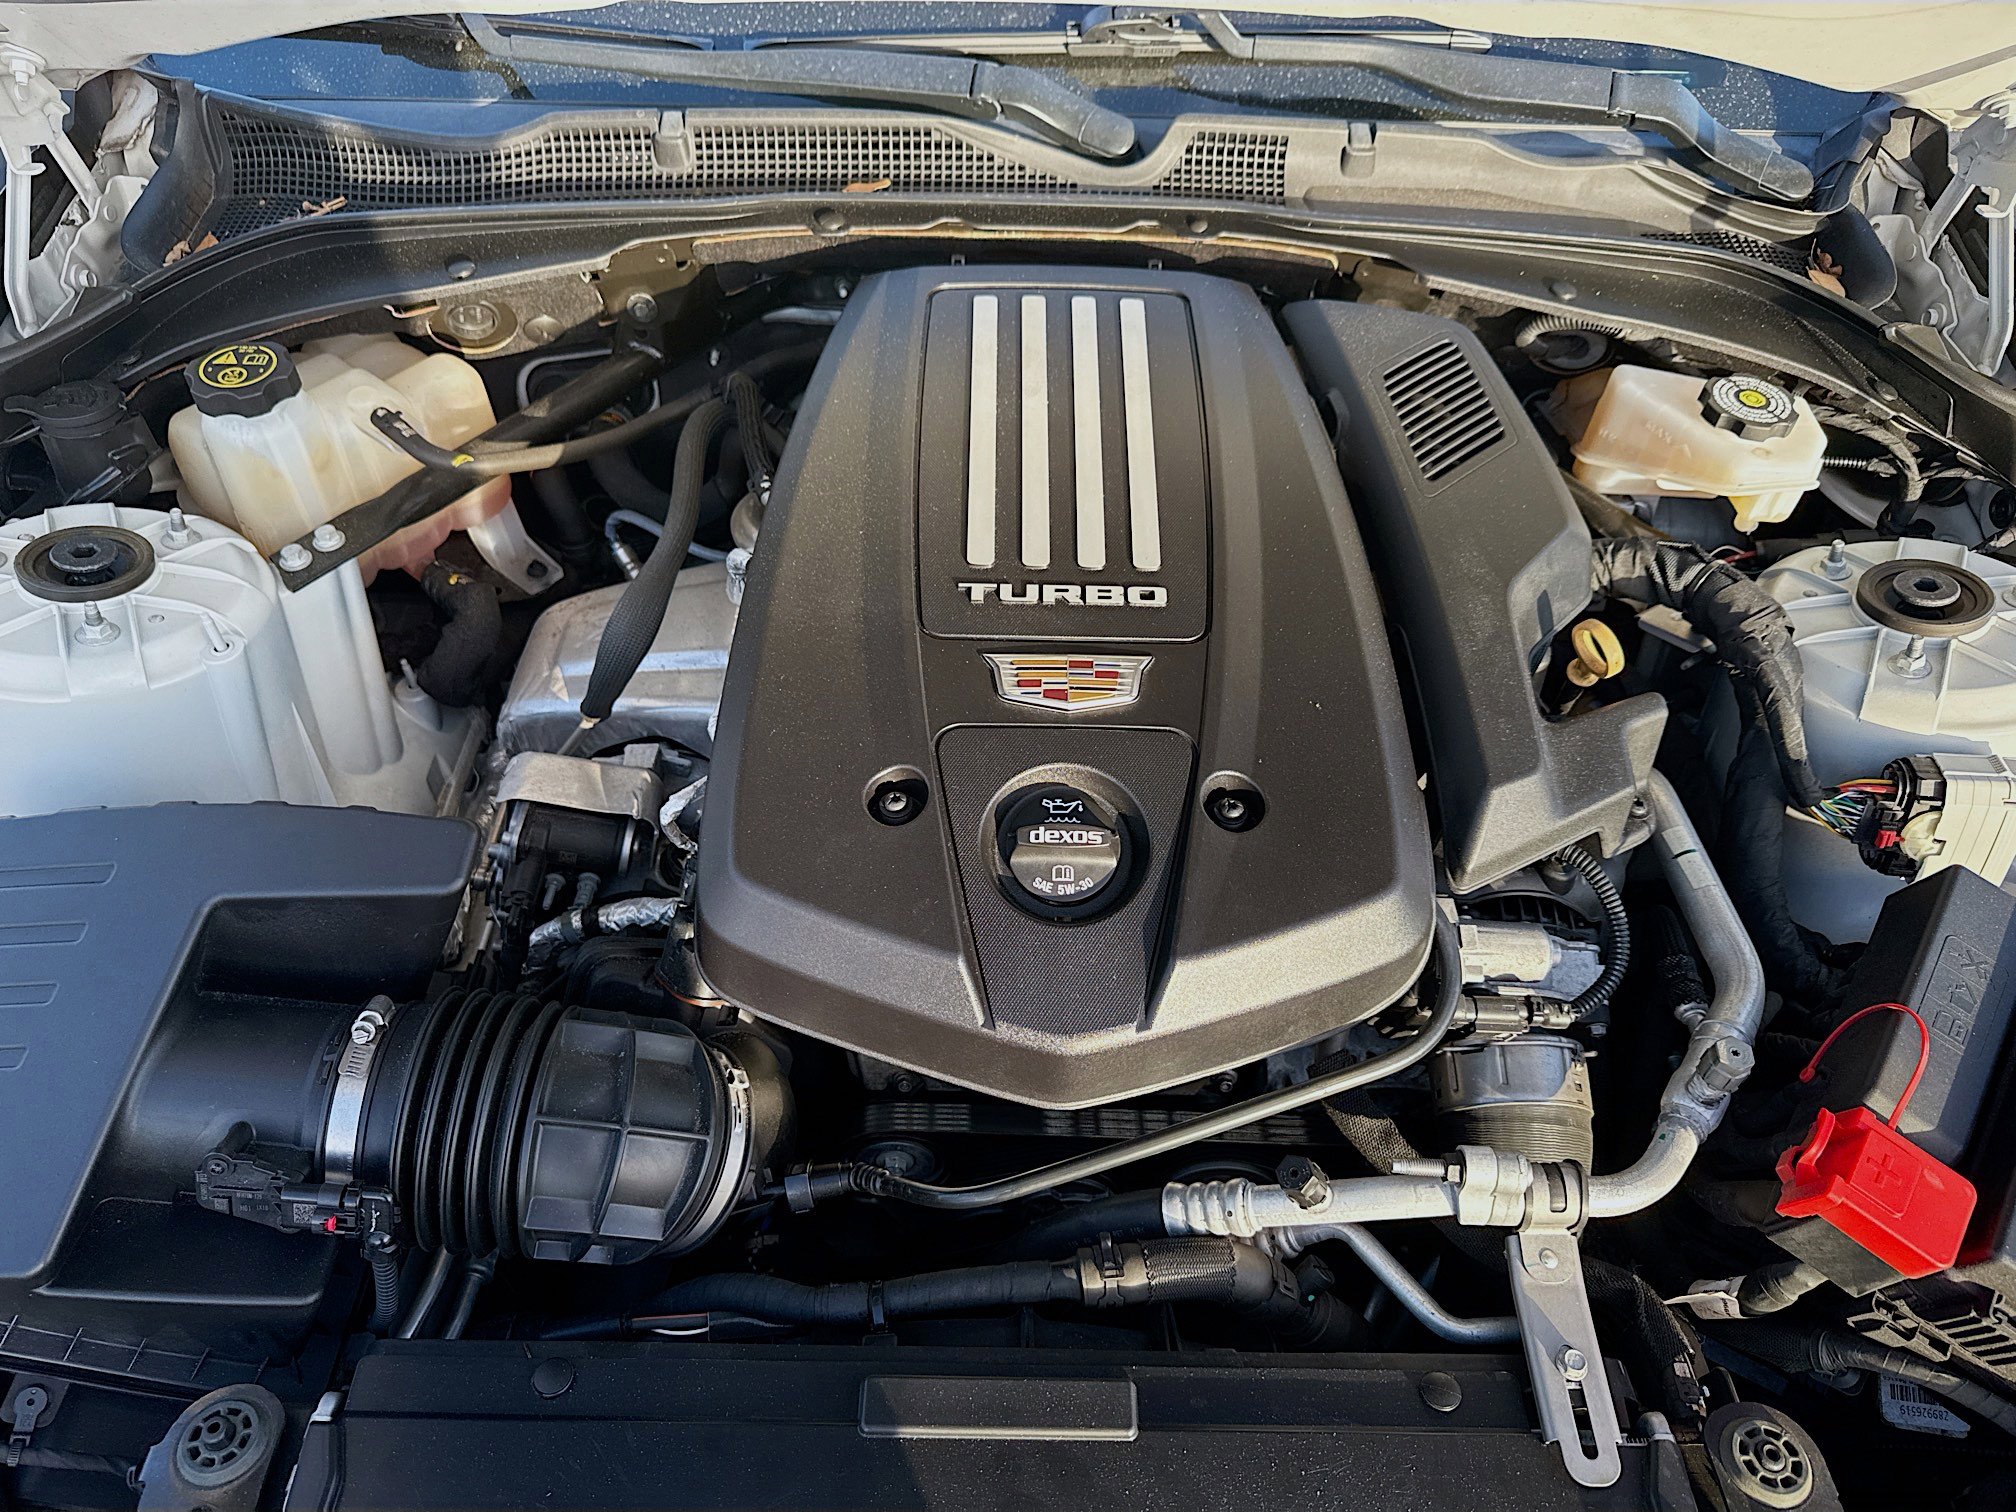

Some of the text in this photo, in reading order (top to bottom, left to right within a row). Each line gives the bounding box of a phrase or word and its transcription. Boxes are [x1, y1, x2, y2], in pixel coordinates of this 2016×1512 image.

[957, 582, 1168, 608] TURBO
[1029, 826, 1105, 845] dexos
[1032, 876, 1094, 896] SAE 5W-30
